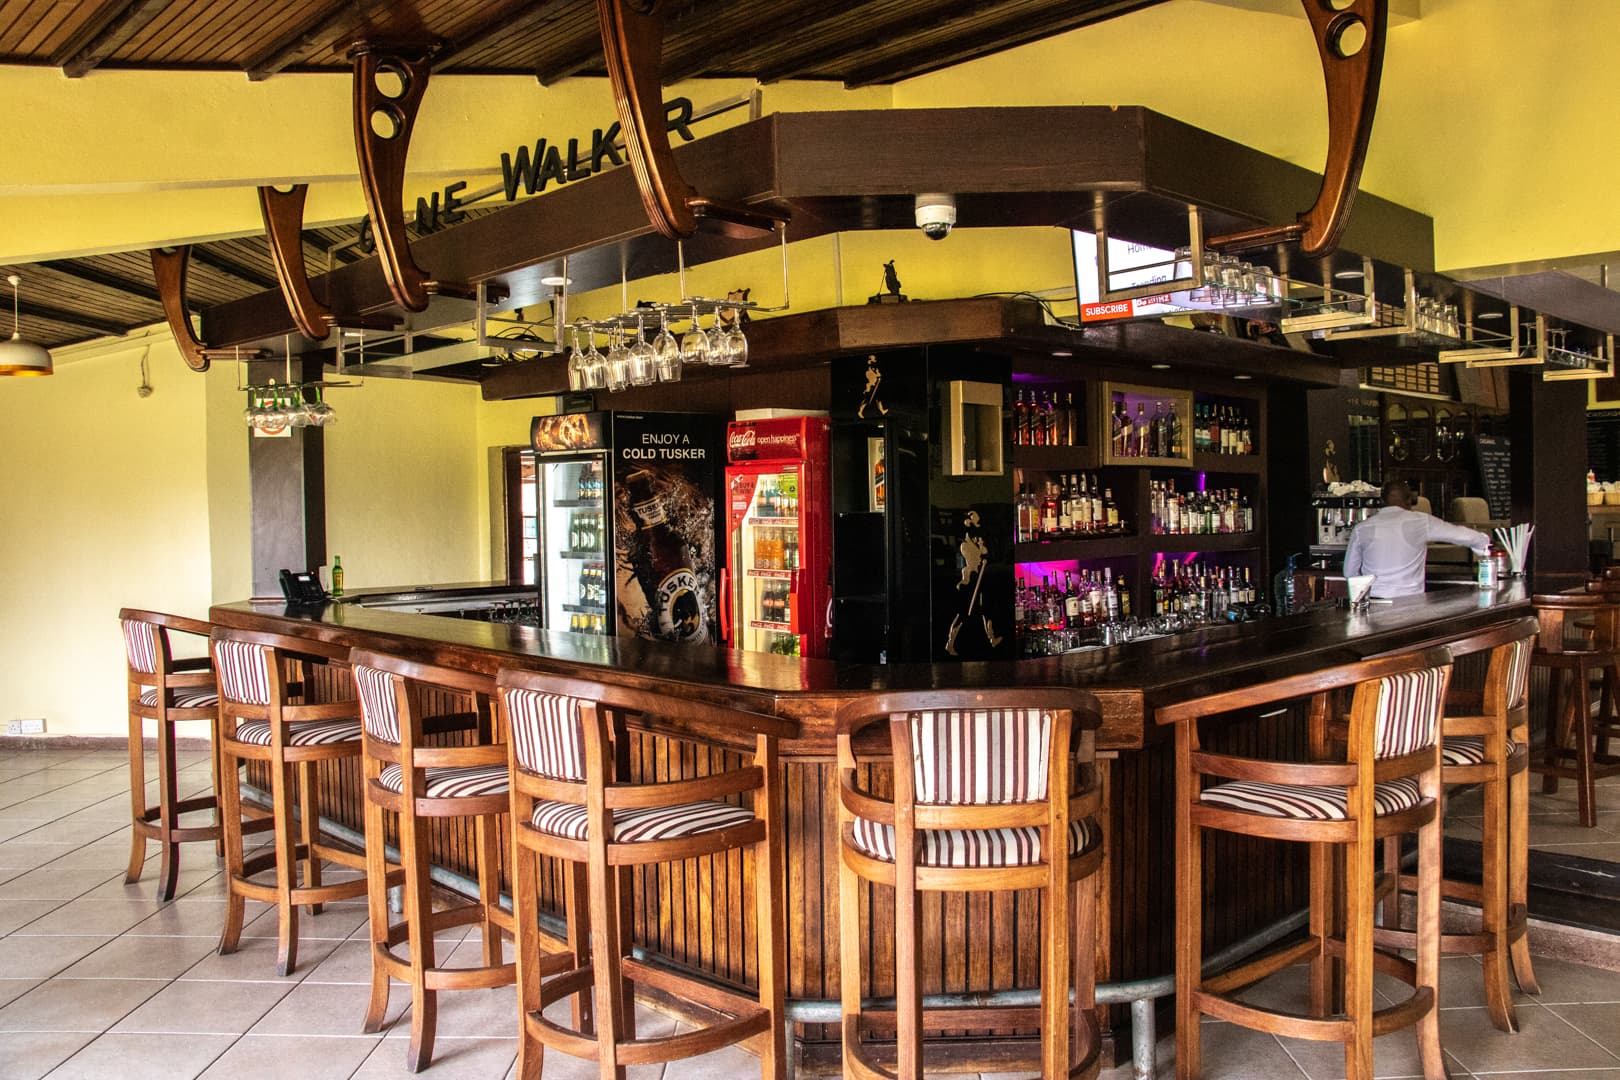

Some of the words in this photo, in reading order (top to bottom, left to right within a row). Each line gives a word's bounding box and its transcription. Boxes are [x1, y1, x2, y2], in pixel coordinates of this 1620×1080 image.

[500, 97, 695, 202] WALKR
[1085, 304, 1129, 317] SUBSCRIBE
[642, 433, 680, 445] ENJOY
[682, 434, 690, 445] A
[622, 448, 656, 460] COLD
[659, 448, 706, 460] TUSKER
